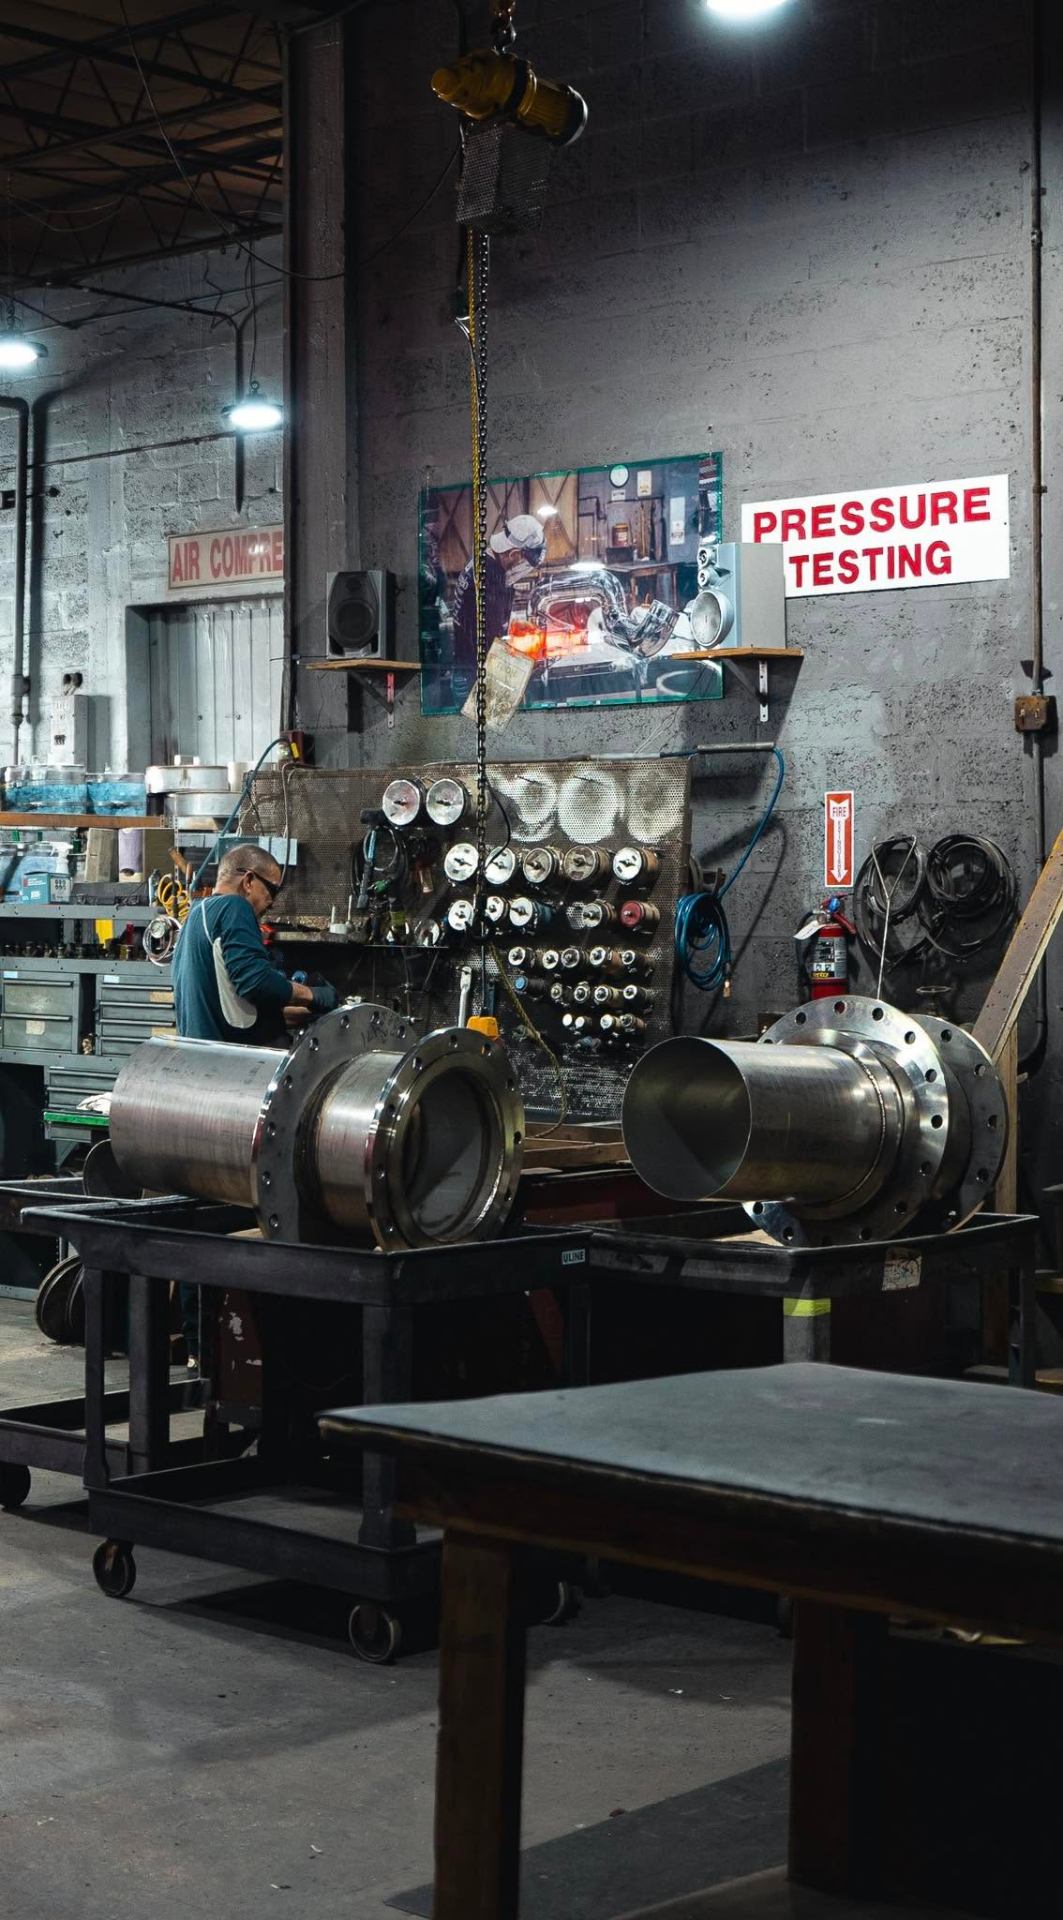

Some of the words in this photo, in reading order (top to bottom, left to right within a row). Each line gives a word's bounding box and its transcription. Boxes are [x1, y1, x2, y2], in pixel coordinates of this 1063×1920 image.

[753, 487, 991, 543] PRESSURE
[172, 541, 200, 582] AIR
[789, 540, 952, 588] TESTING
[832, 806, 847, 817] FIRE
[563, 1250, 584, 1263] ULINE
